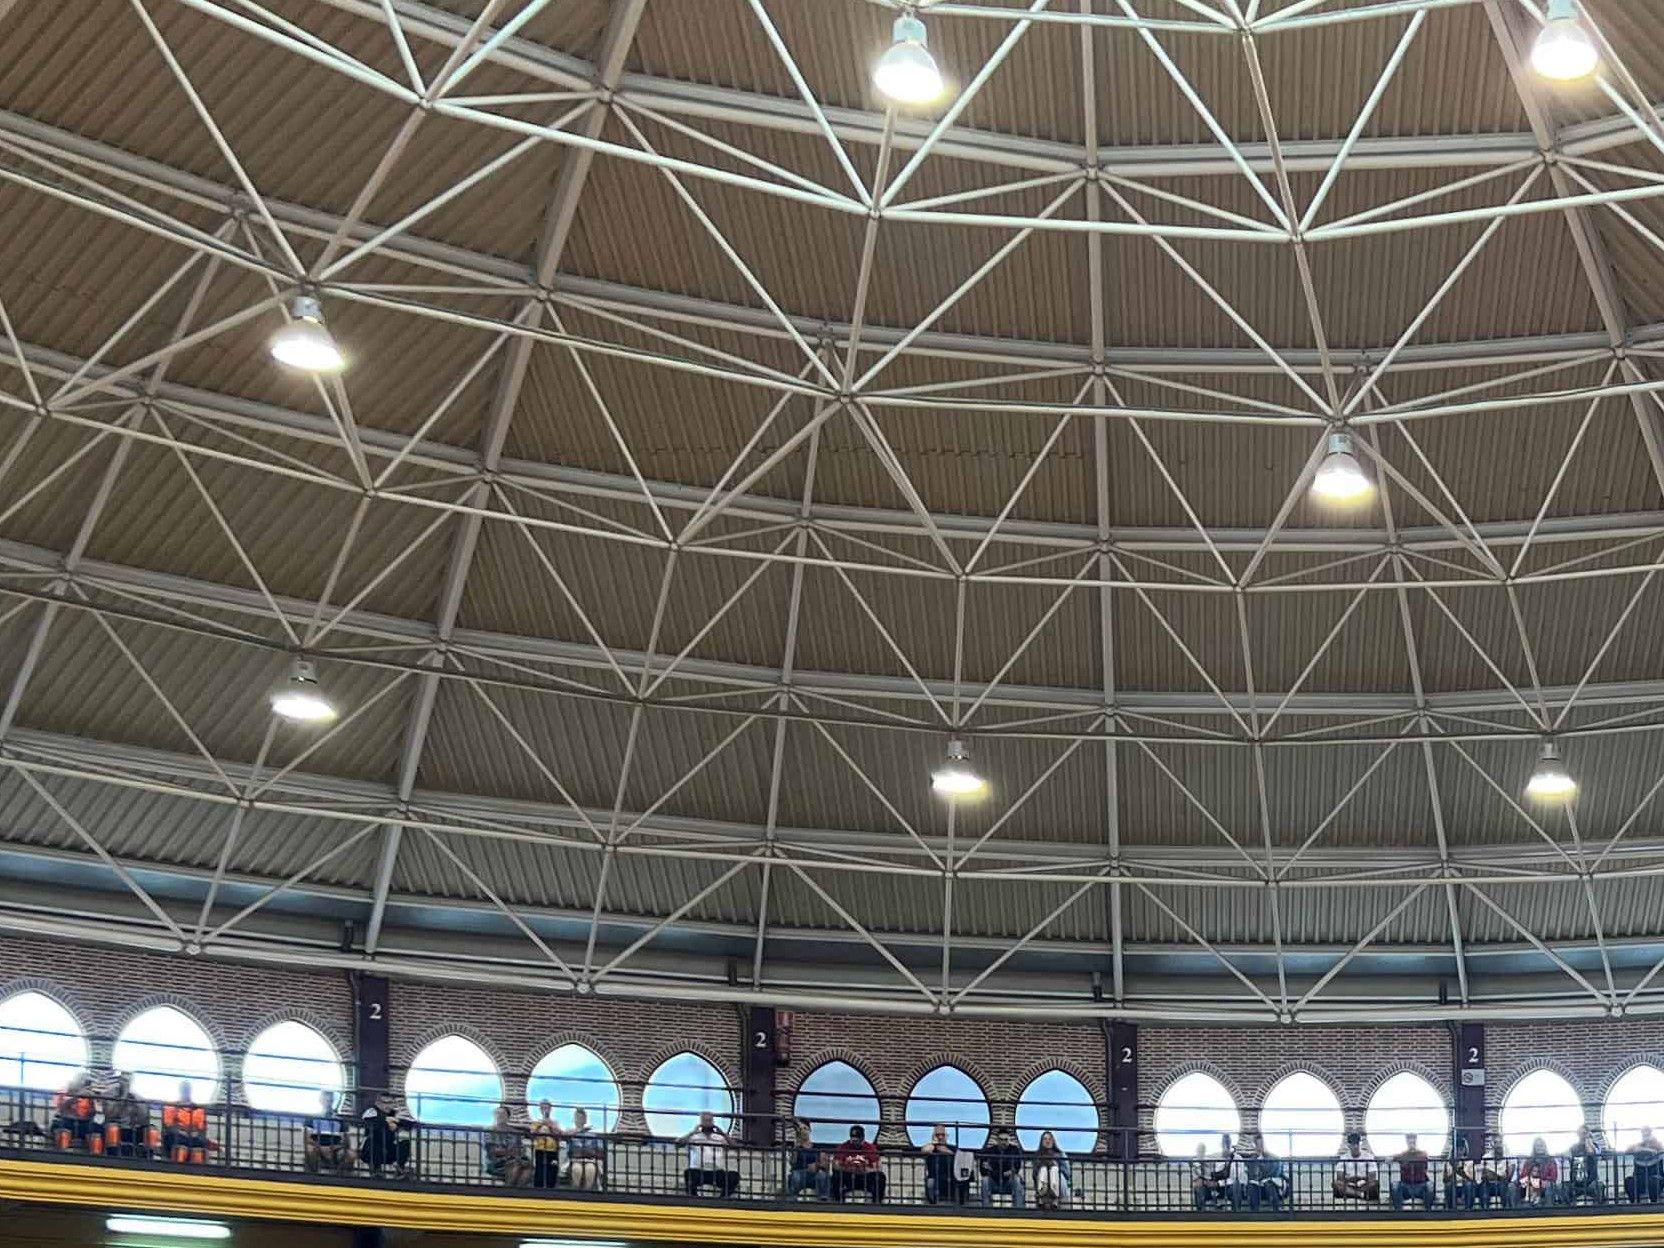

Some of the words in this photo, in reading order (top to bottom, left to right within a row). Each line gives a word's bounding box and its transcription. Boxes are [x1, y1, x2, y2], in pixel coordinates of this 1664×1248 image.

[369, 1003, 382, 1019] 2
[755, 1032, 767, 1048] 2
[1121, 1047, 1133, 1063] 2
[1468, 1047, 1479, 1063] 2
